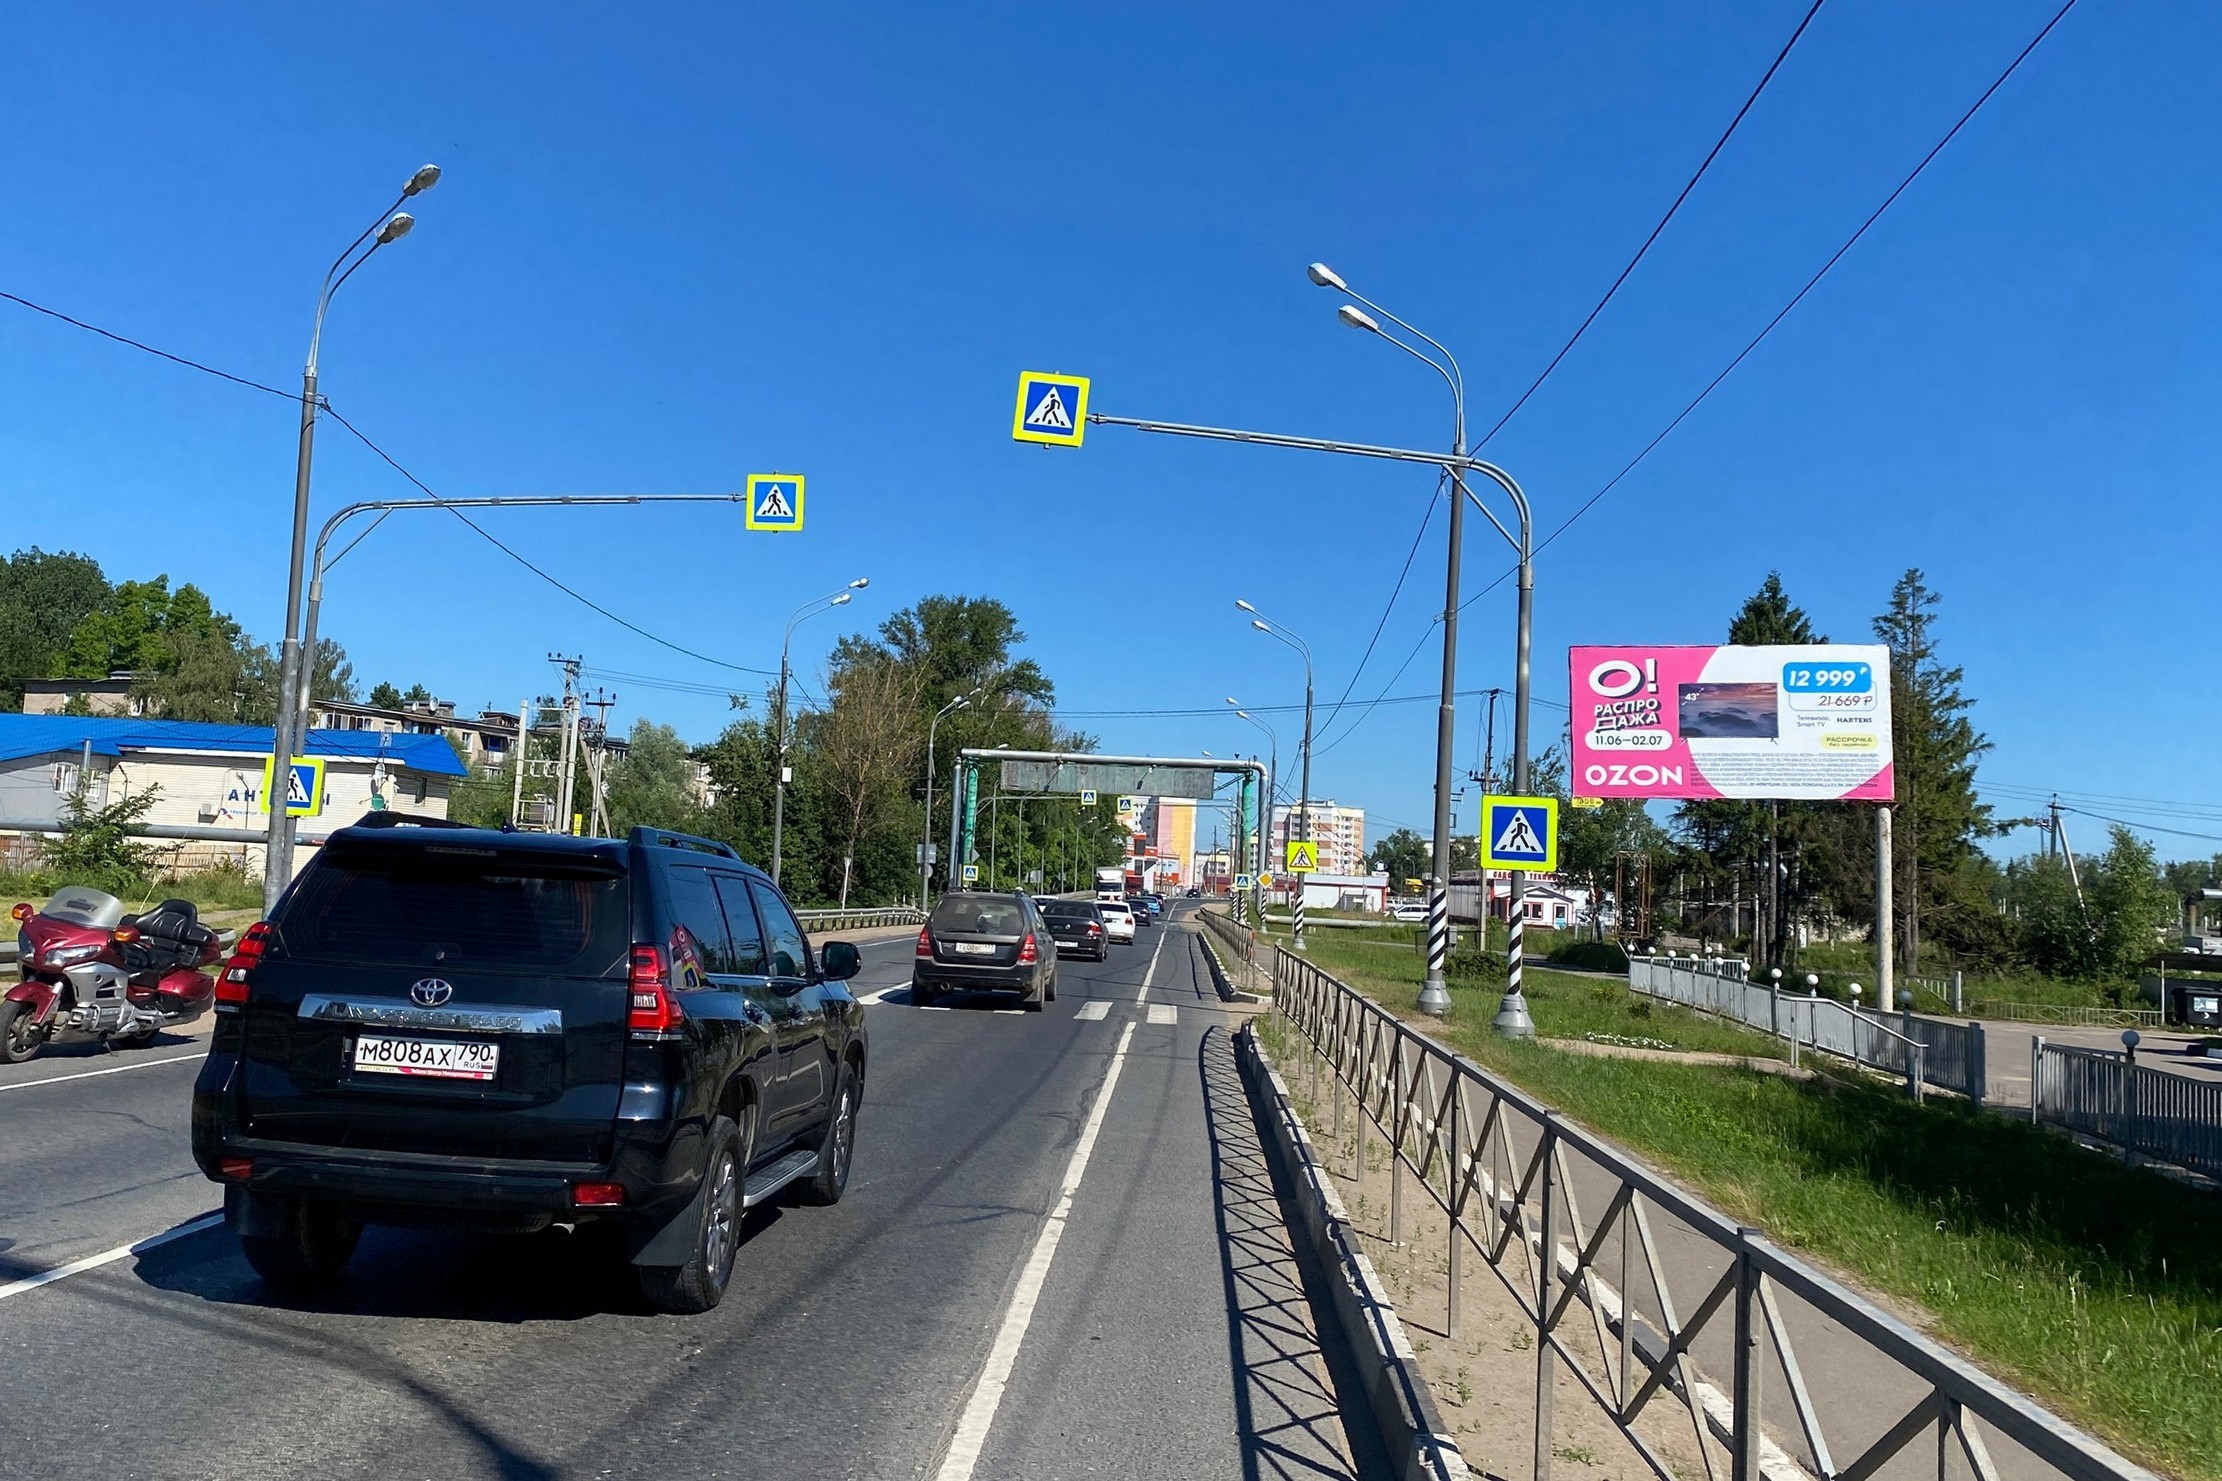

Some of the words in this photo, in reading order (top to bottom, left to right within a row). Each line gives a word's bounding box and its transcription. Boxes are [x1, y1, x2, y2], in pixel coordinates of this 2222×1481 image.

[1789, 671, 1811, 687] 12
[1815, 670, 1856, 687] 999
[1594, 698, 1660, 717] РАСПРО
[1818, 695, 1833, 707] 21
[1835, 695, 1861, 707] 669
[1593, 712, 1660, 732] ДАЖА
[1585, 764, 1683, 786] OZON
[1529, 873, 1557, 881] ТЕХНИ
[462, 1014, 522, 1028] PRADO
[362, 1039, 452, 1066] М808АХ
[458, 1044, 491, 1062] 790
[463, 1061, 480, 1069] RUS
